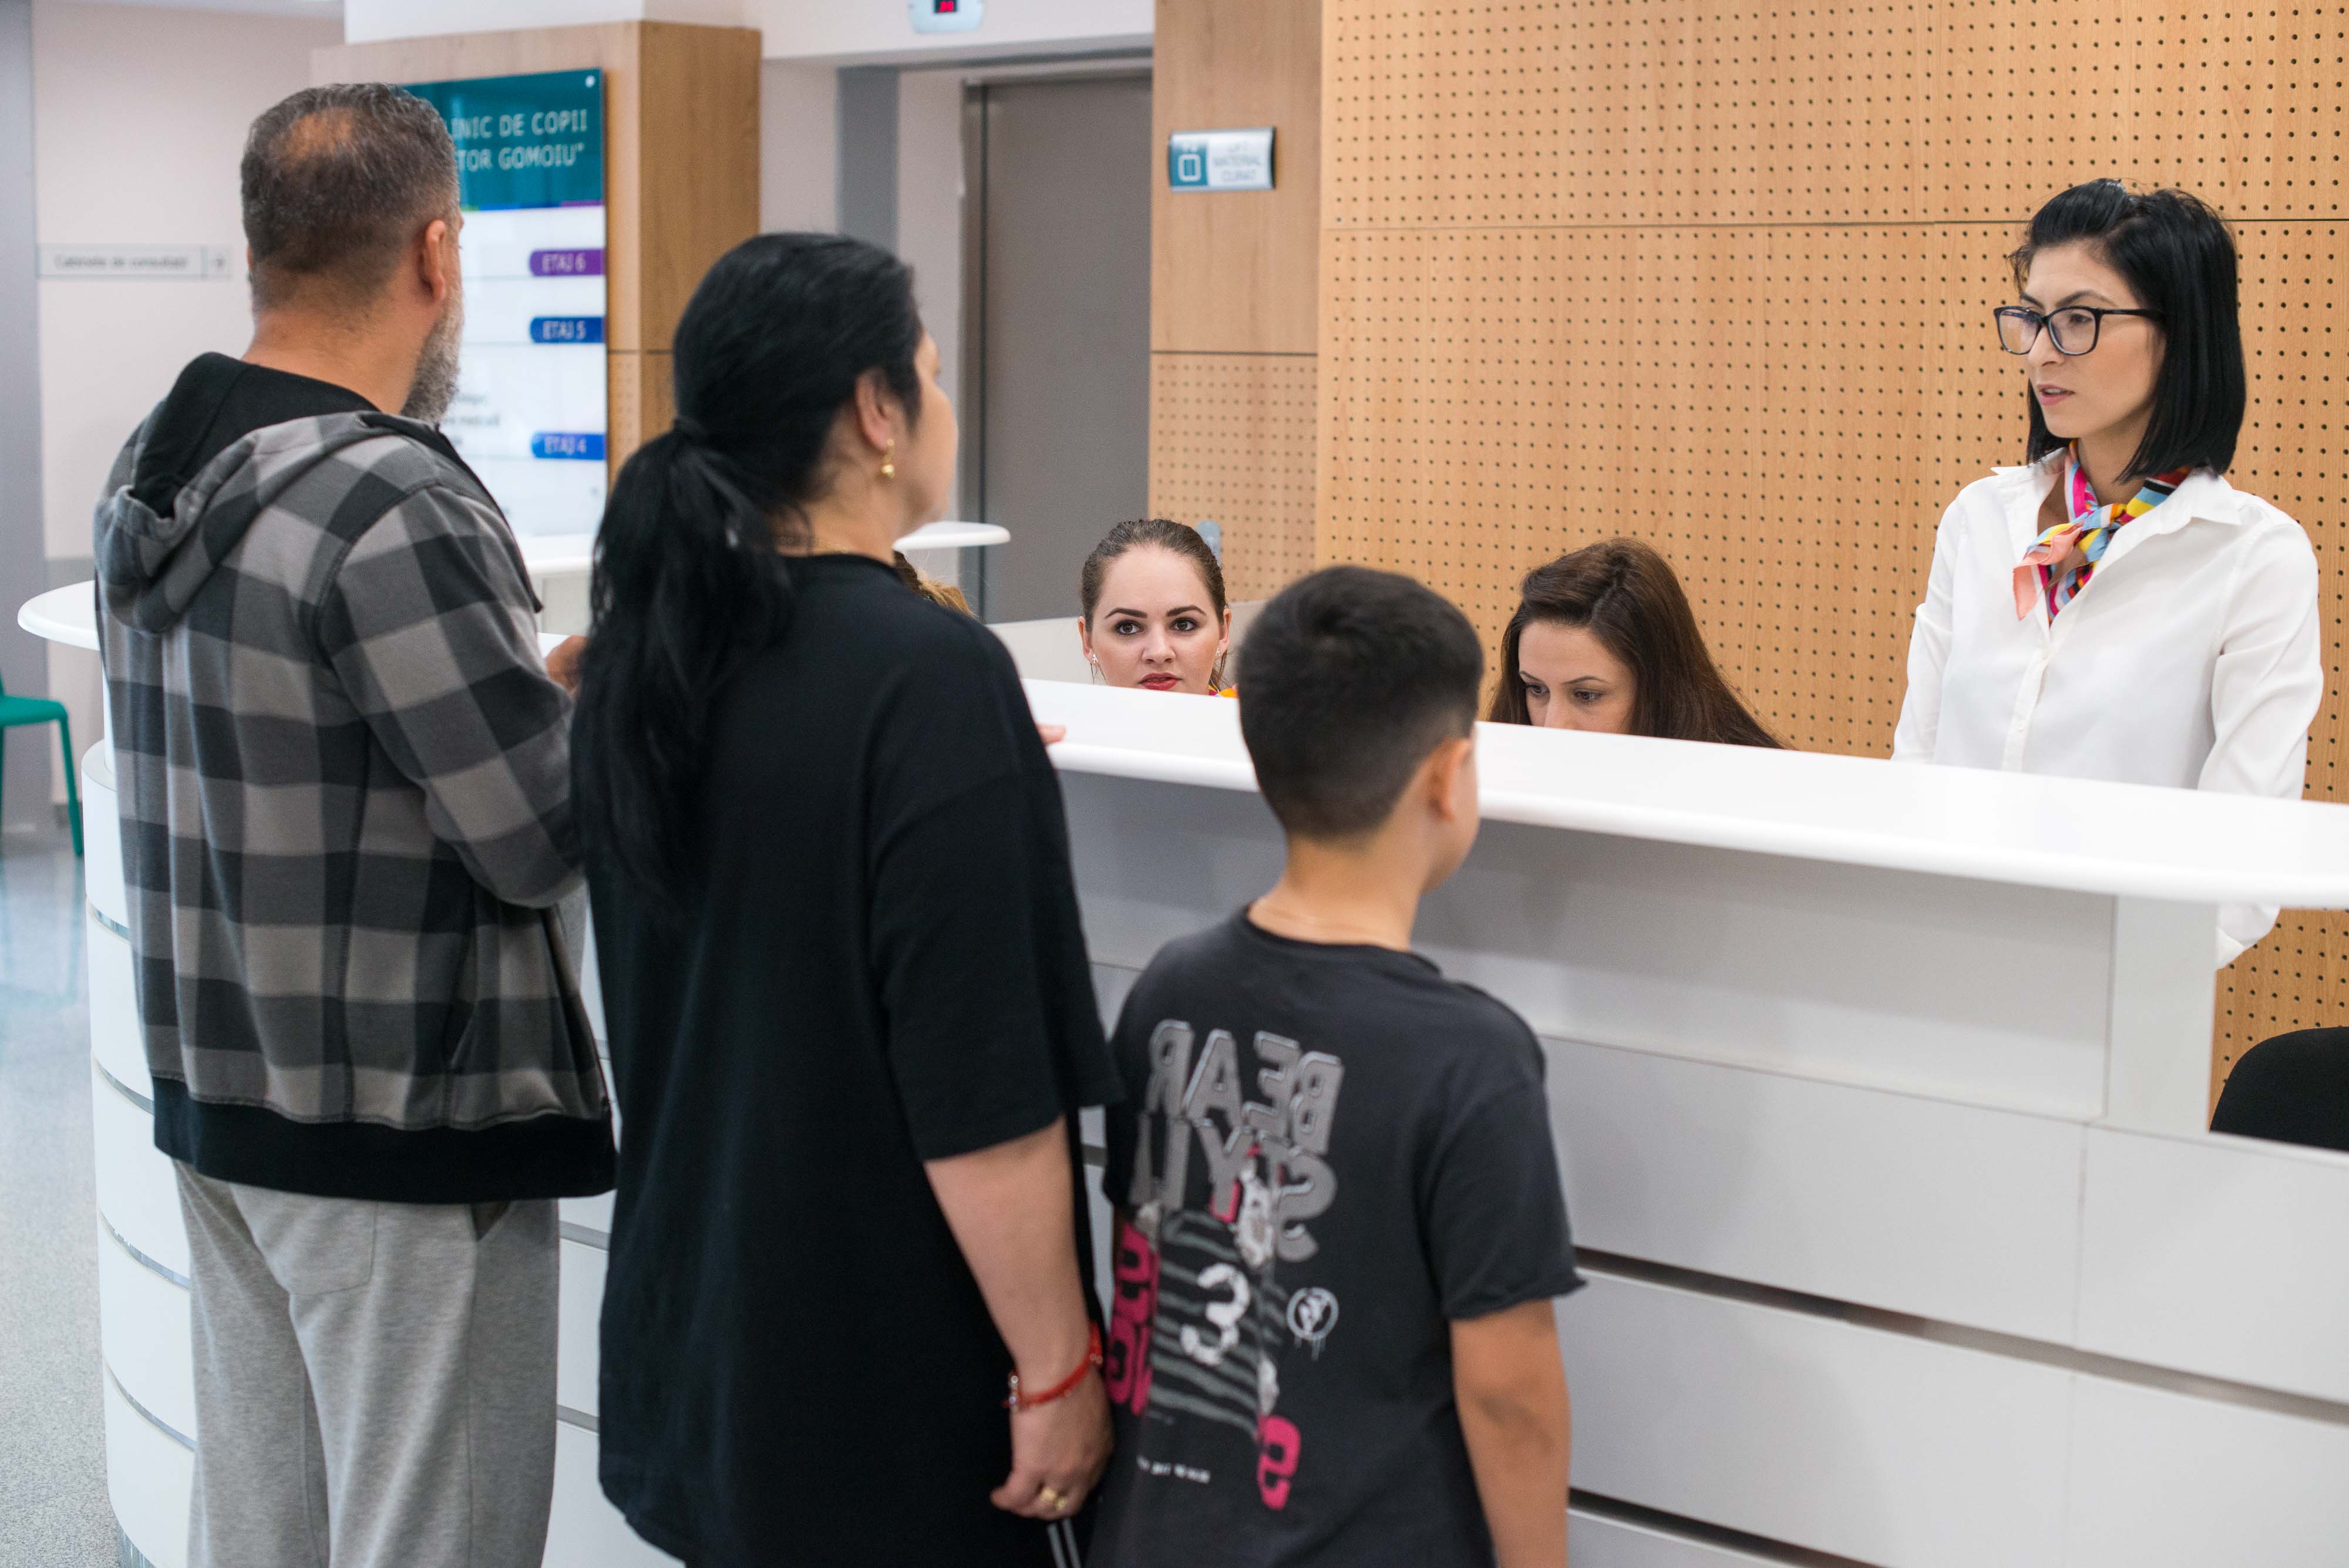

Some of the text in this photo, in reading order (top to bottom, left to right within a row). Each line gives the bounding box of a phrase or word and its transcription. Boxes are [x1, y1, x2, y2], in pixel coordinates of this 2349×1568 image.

[452, 109, 587, 140] INIC DE COPII
[456, 149, 493, 172] TOR
[542, 253, 586, 272] ETAJ 6
[542, 320, 587, 339] ETAJ 5
[544, 435, 587, 455] ETAJ 4
